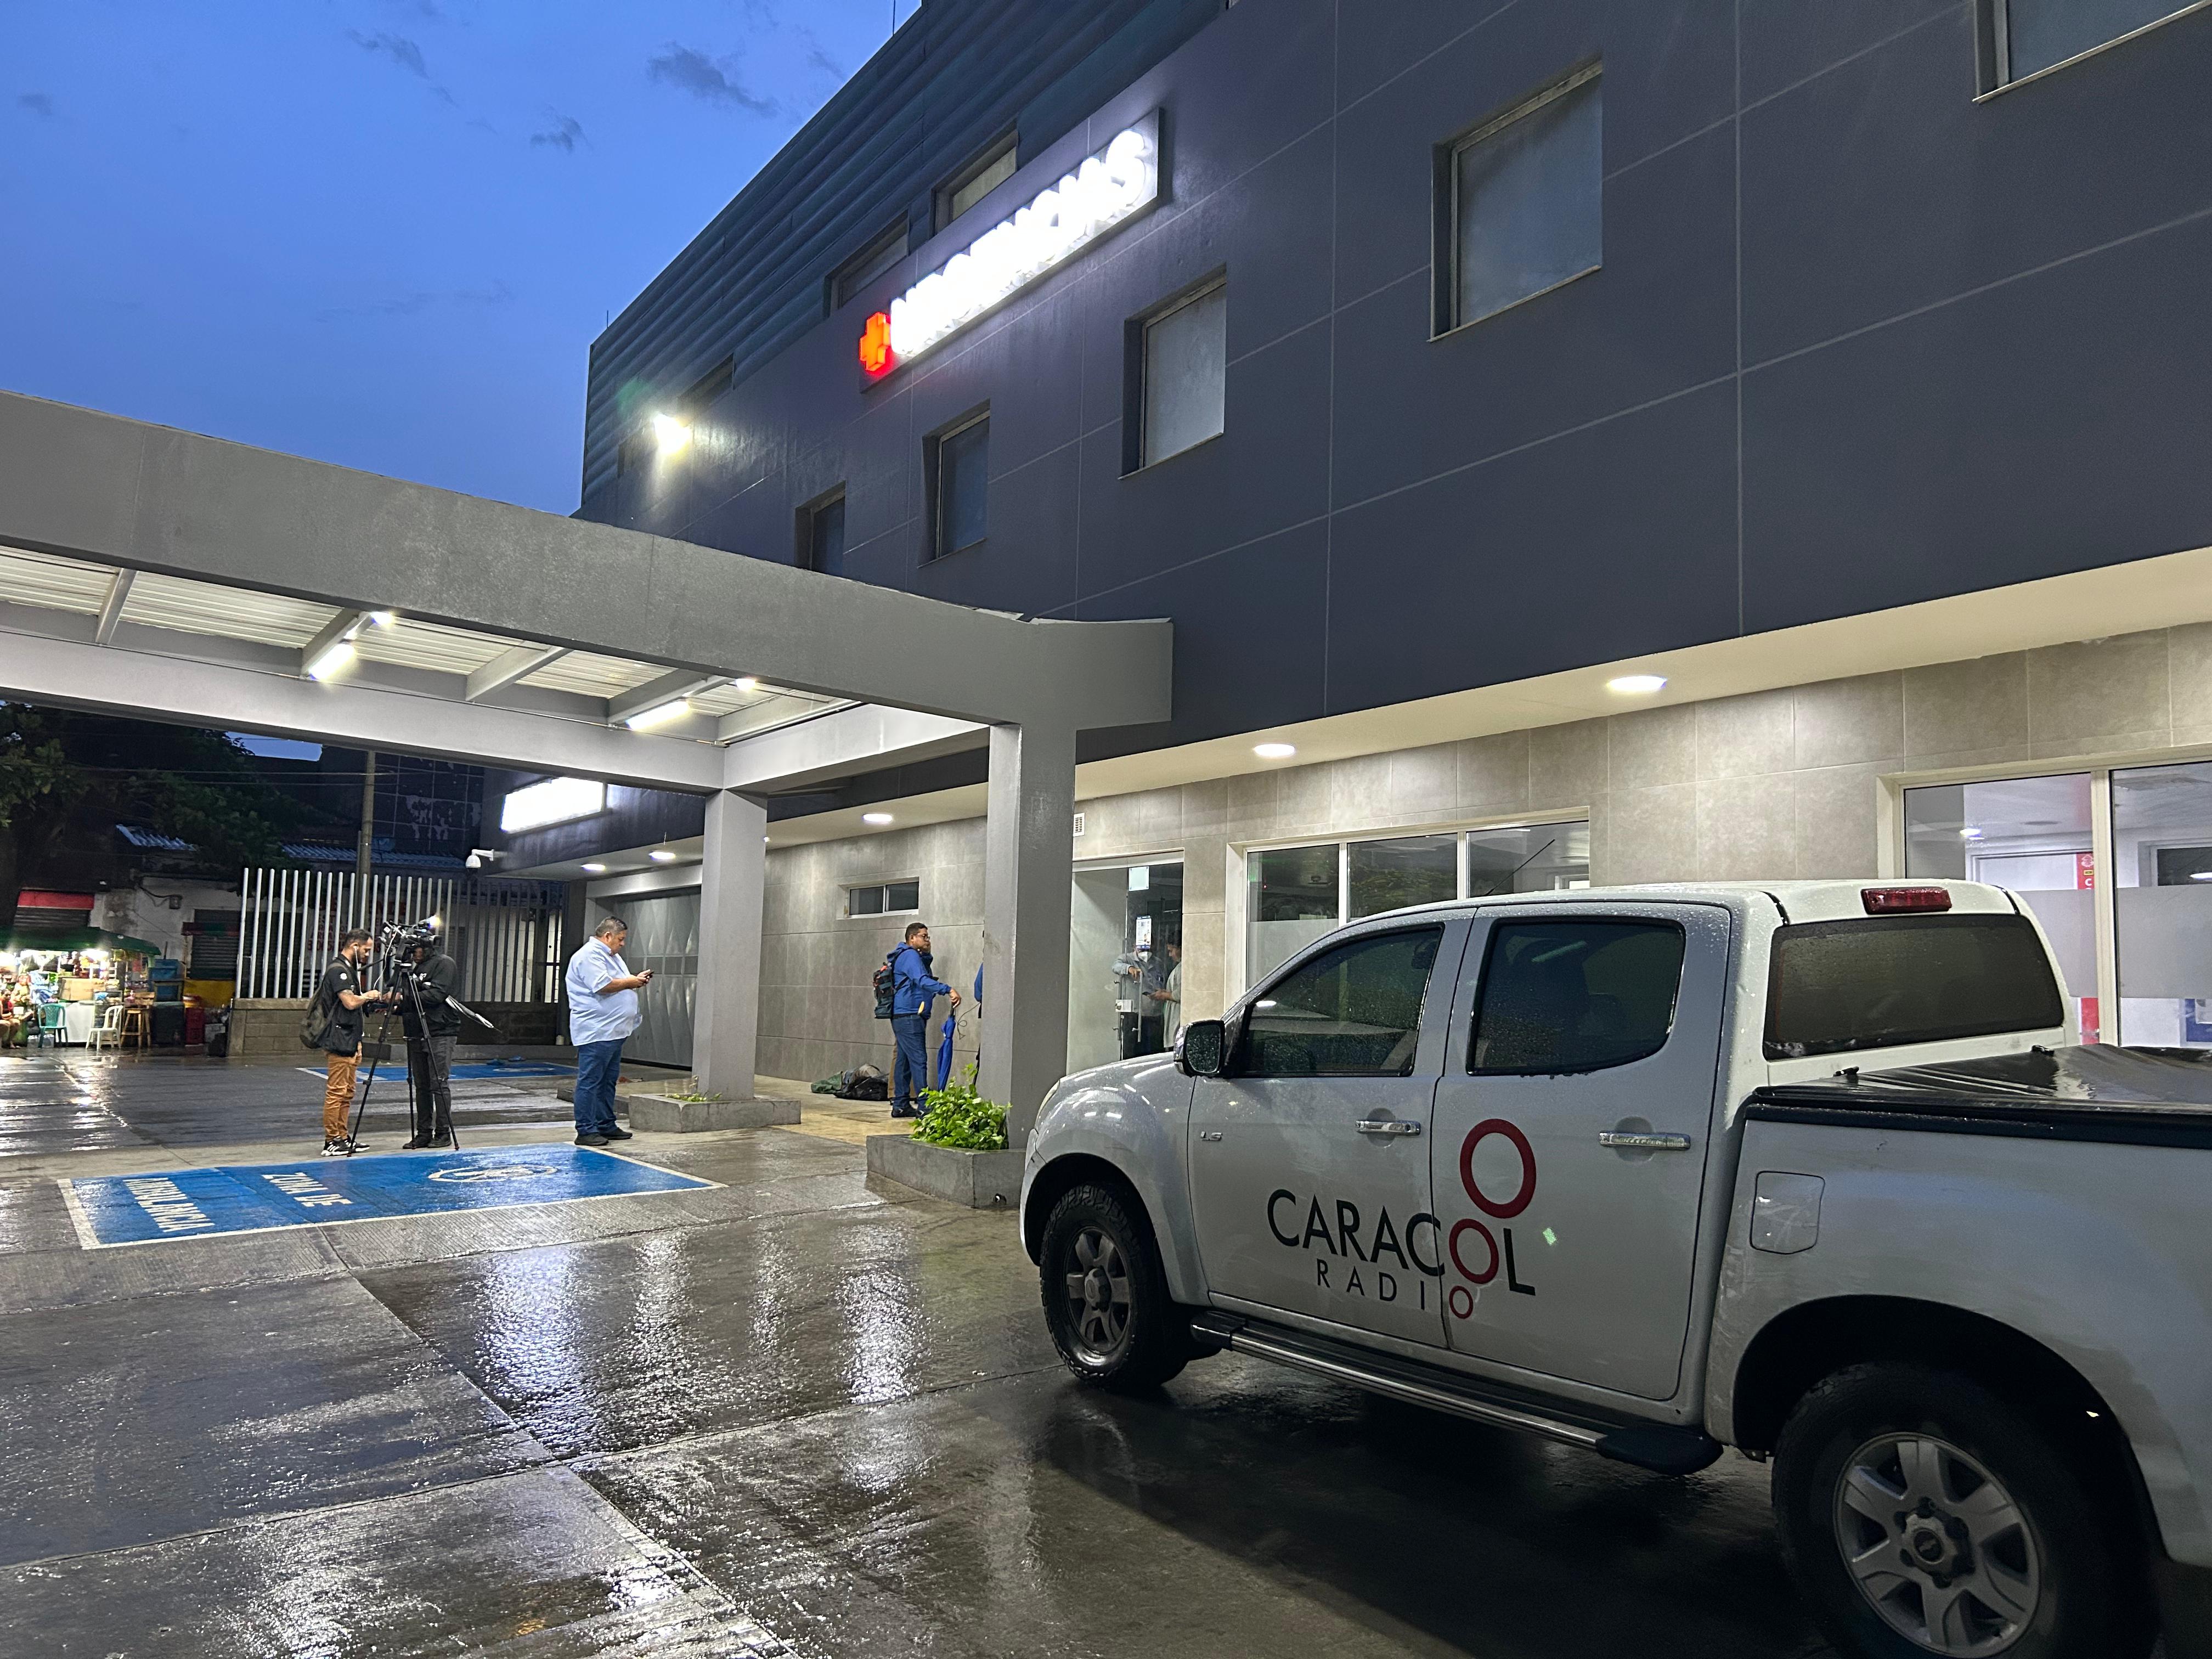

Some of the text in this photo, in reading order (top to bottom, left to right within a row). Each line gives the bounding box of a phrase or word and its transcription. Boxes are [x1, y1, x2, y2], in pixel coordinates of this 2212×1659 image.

[1200, 1131, 1223, 1142] LS
[122, 1177, 215, 1232] AMBULANCIA
[261, 1172, 353, 1207] ZONA DE
[1267, 1189, 1536, 1296] CARACOL
[1317, 1258, 1474, 1319] RADIO
